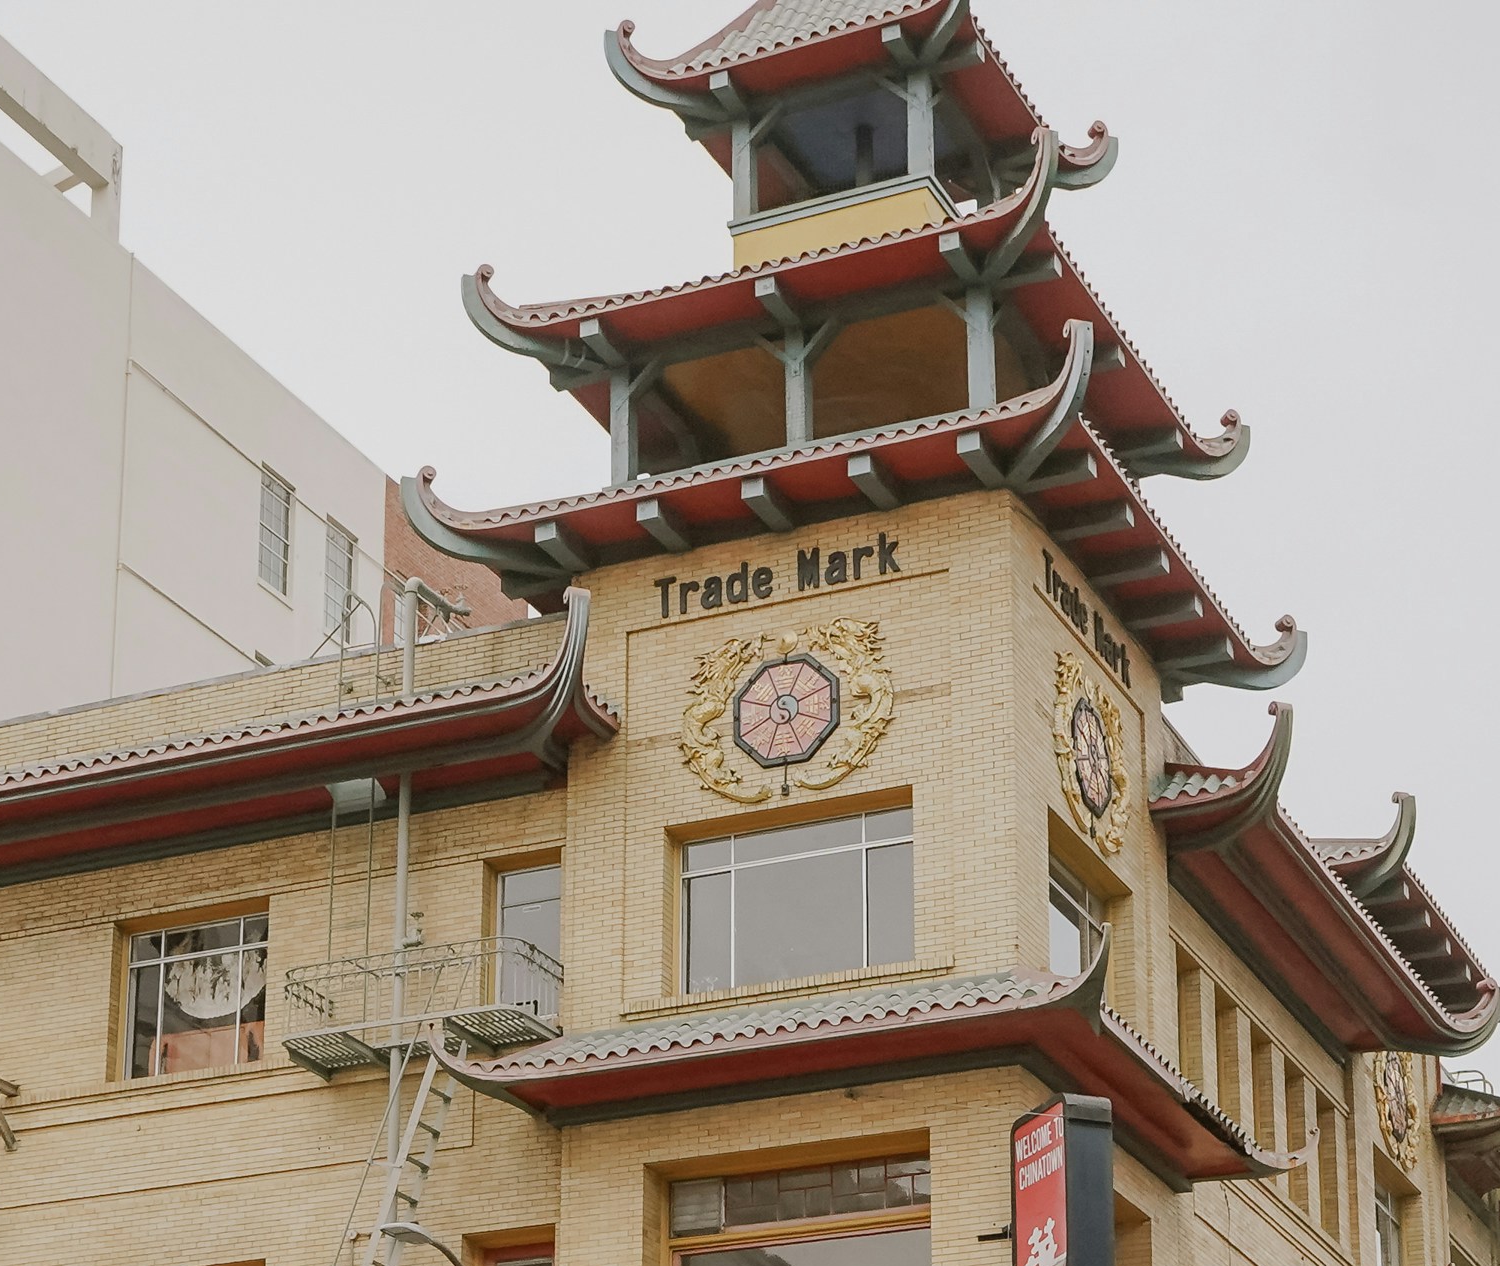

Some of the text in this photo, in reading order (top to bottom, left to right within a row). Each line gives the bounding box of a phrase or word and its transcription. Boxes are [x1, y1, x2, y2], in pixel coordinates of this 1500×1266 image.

[654, 533, 900, 618] Trade Mark
[1042, 548, 1089, 637] Trade
[1015, 1115, 1064, 1163] WELCOME TO
[1019, 1145, 1063, 1191] CHINATOWN
